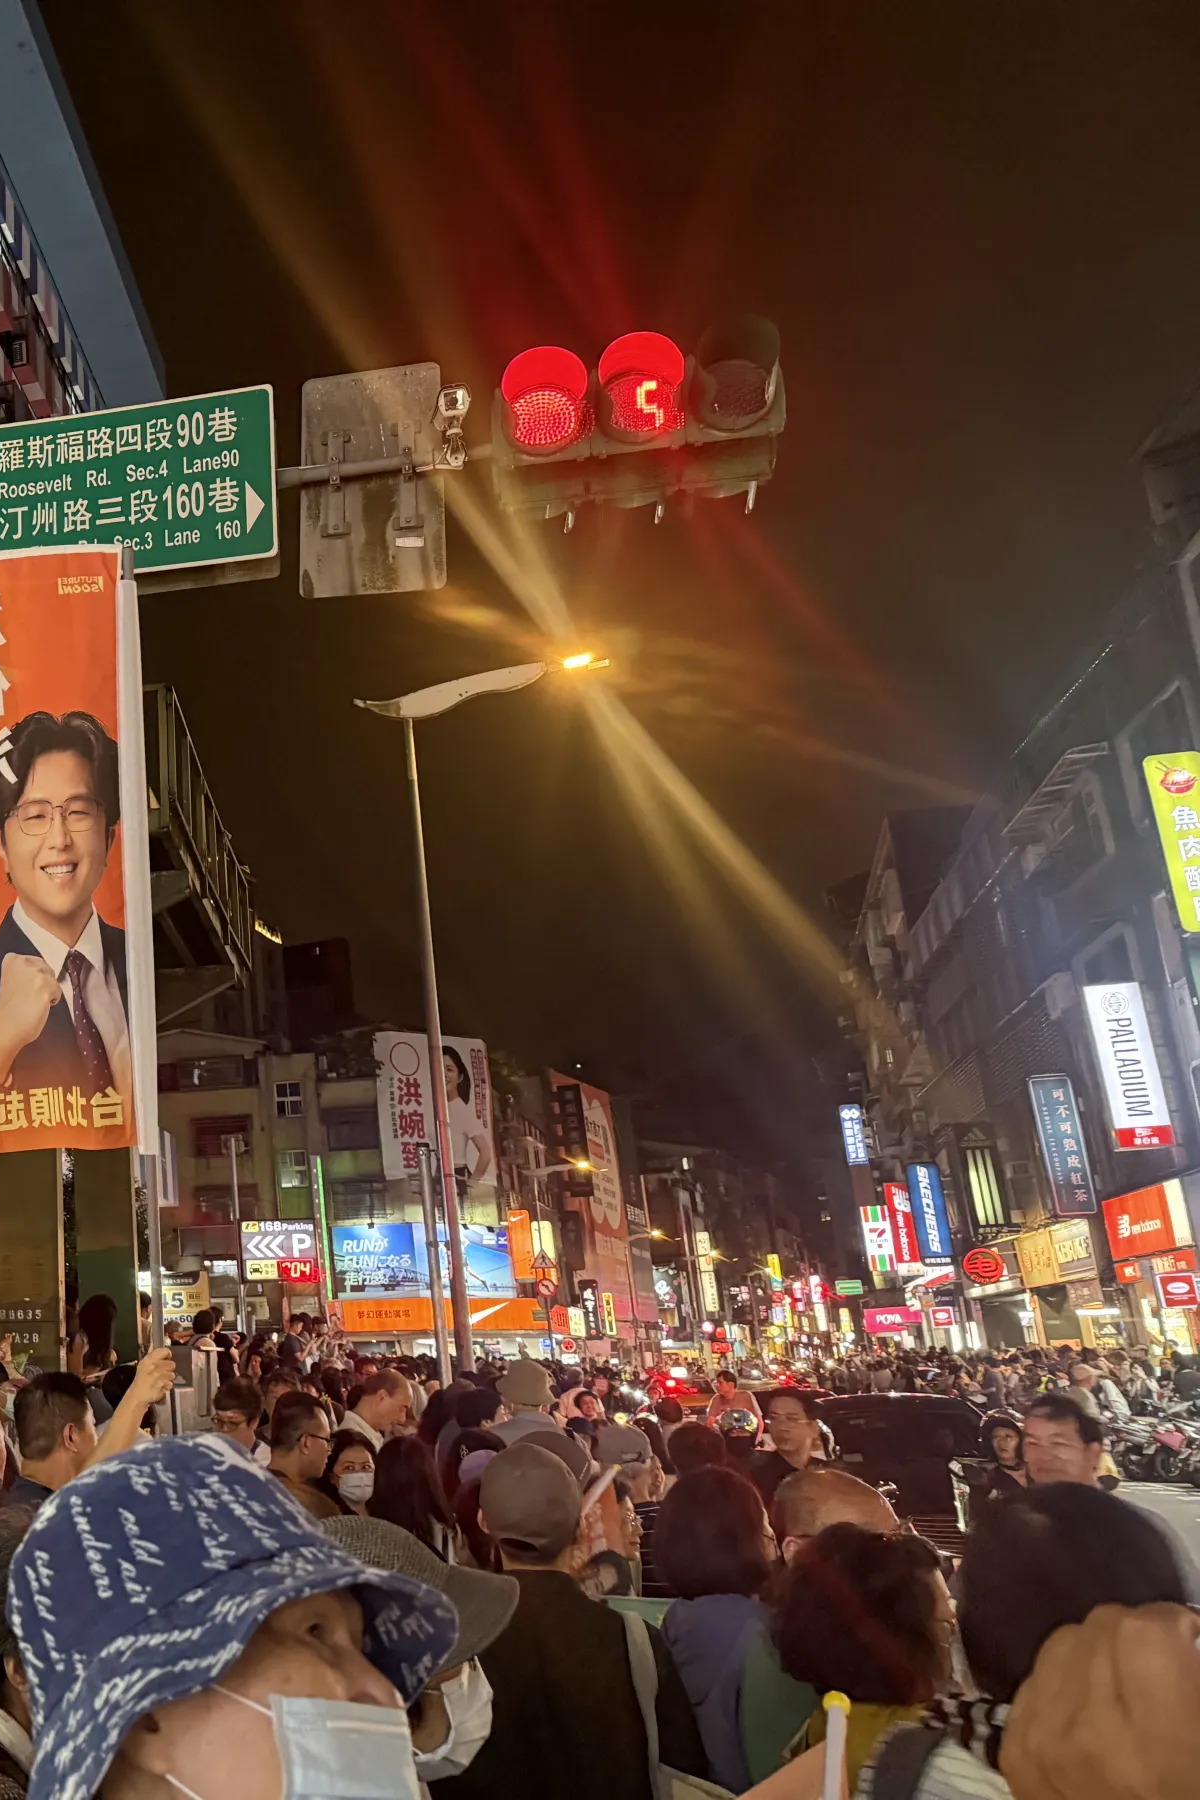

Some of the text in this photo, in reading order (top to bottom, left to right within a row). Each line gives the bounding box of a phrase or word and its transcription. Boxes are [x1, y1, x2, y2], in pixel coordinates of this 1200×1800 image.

[86, 469, 111, 488] Rd.
[126, 462, 168, 482] Sec.4
[183, 449, 239, 475] Lane90
[0, 476, 240, 540] 汀州路三段160巷
[165, 527, 201, 548] Lane
[215, 520, 242, 540] 160
[1106, 1017, 1153, 1117] PALLADIUM
[1052, 1088, 1089, 1202] 可不可熟成紅茶
[895, 1211, 904, 1228] new
[916, 1165, 942, 1253] SKECHERS
[259, 1221, 313, 1232] 168 Parking
[292, 1233, 311, 1258] P
[343, 1238, 388, 1252] RUNが
[899, 1228, 911, 1261] balance
[344, 1254, 411, 1268] FUNになる
[875, 1313, 903, 1325] POYA
[5, 1332, 39, 1344] A28
